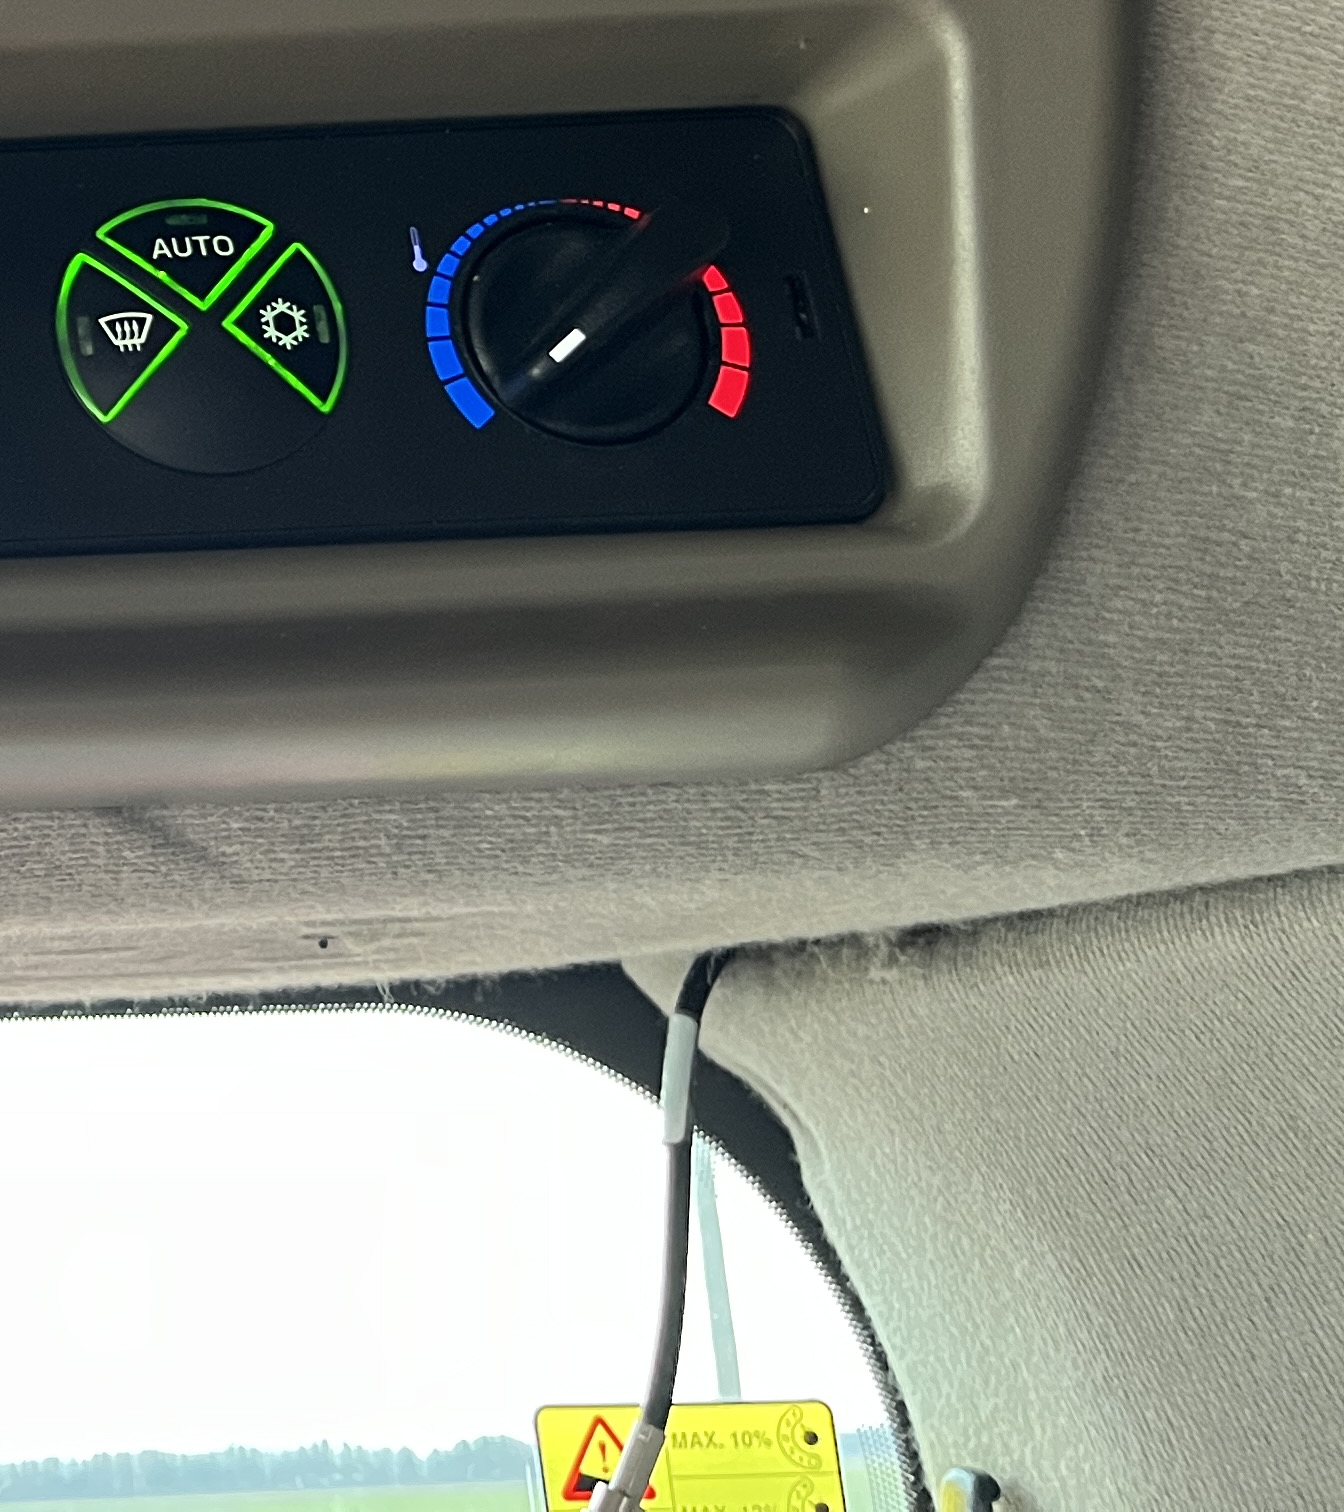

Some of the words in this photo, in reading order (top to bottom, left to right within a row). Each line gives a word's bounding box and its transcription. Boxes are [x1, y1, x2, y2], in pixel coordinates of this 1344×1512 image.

[152, 235, 235, 260] AUTO
[671, 1430, 725, 1449] MAX.
[730, 1429, 773, 1449] 10%
